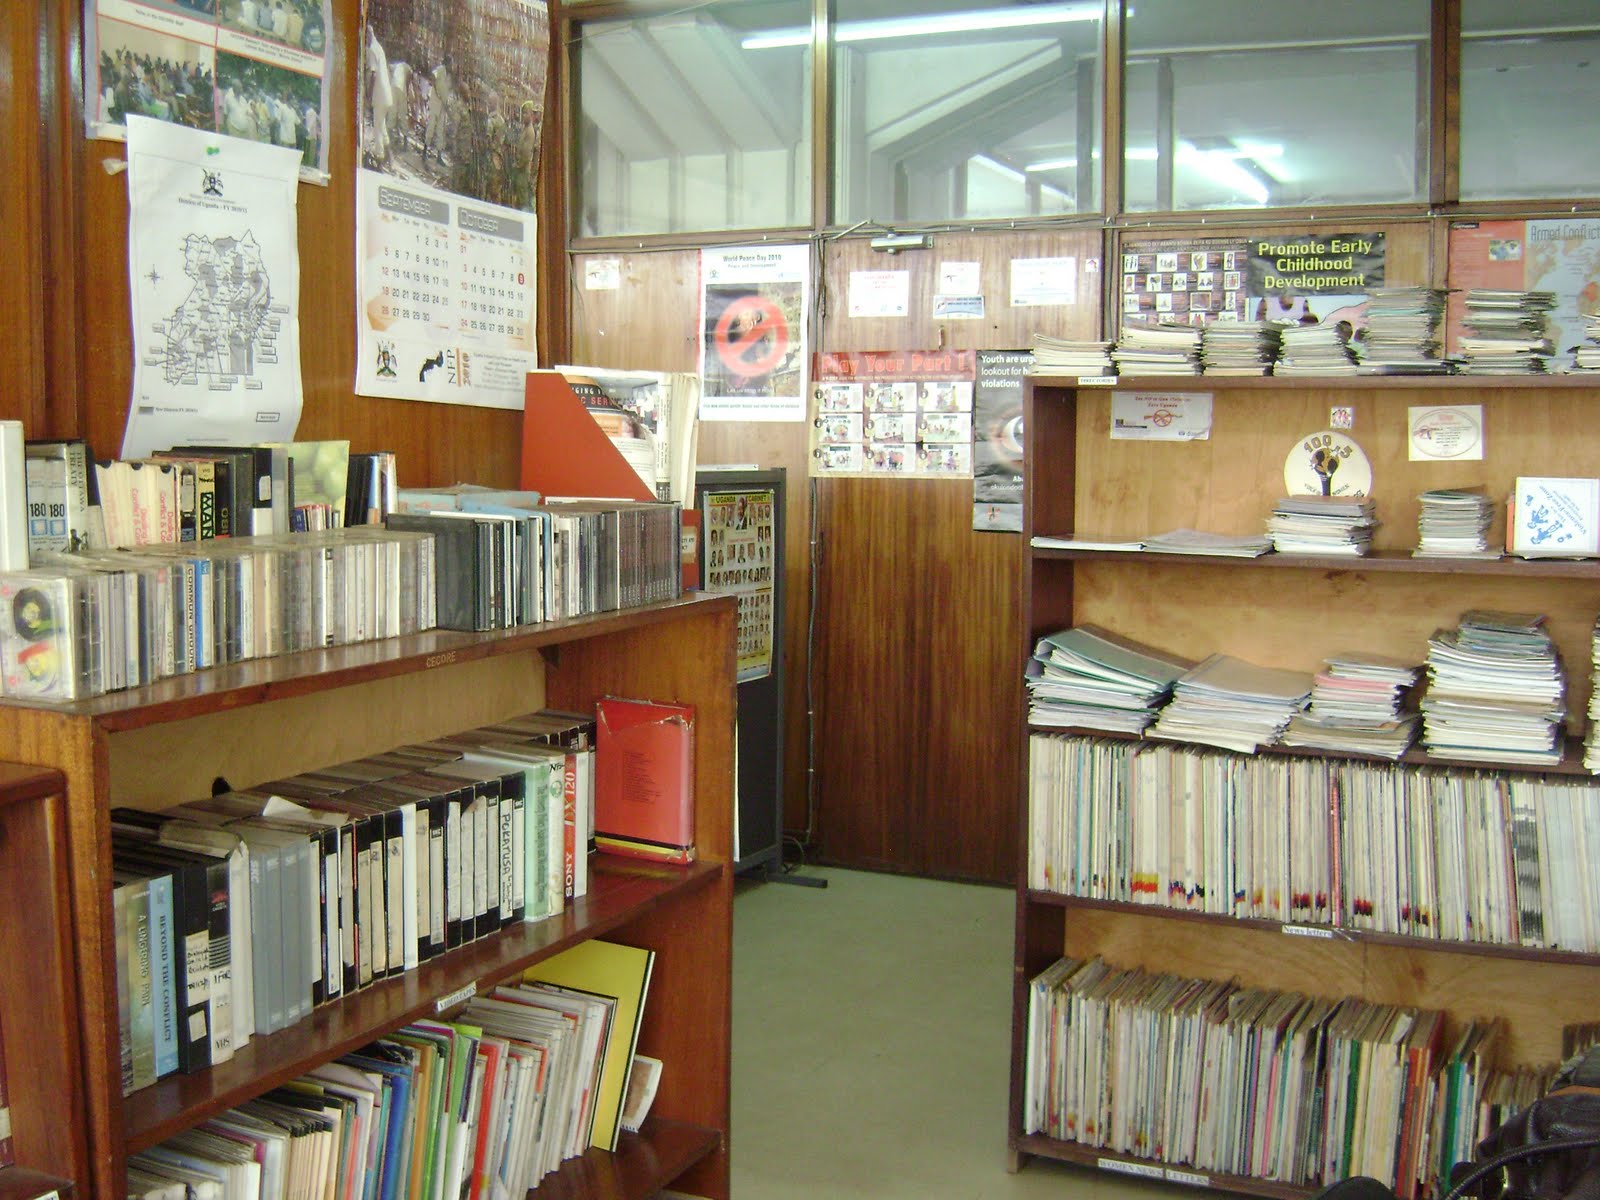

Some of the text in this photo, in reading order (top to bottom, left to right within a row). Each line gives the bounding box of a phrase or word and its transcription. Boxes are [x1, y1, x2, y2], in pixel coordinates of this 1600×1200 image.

[380, 188, 431, 215] SEPTEMBER
[461, 210, 498, 232] OCTOBER
[1531, 226, 1560, 240] Armed
[1258, 240, 1325, 256] Promote
[1332, 239, 1372, 256] Early
[1277, 257, 1352, 272] Childhood
[1264, 274, 1365, 290] Development
[822, 355, 860, 376] Play
[864, 355, 904, 372] Your
[911, 354, 951, 372] Part
[982, 355, 1004, 363] Youth
[982, 366, 1009, 375] lookout
[1011, 367, 1021, 375] for
[981, 379, 1020, 388] violations
[30, 503, 46, 517] 180
[50, 504, 64, 517] 180
[426, 650, 456, 667] CECORE
[565, 772, 575, 796] 120
[160, 916, 168, 961] BEYOND
[138, 927, 149, 979] LINGERING
[141, 984, 150, 1006] PAIN
[216, 1038, 230, 1049] VHS
[1100, 1160, 1206, 1184] WOMEN NEWS LETTERS
